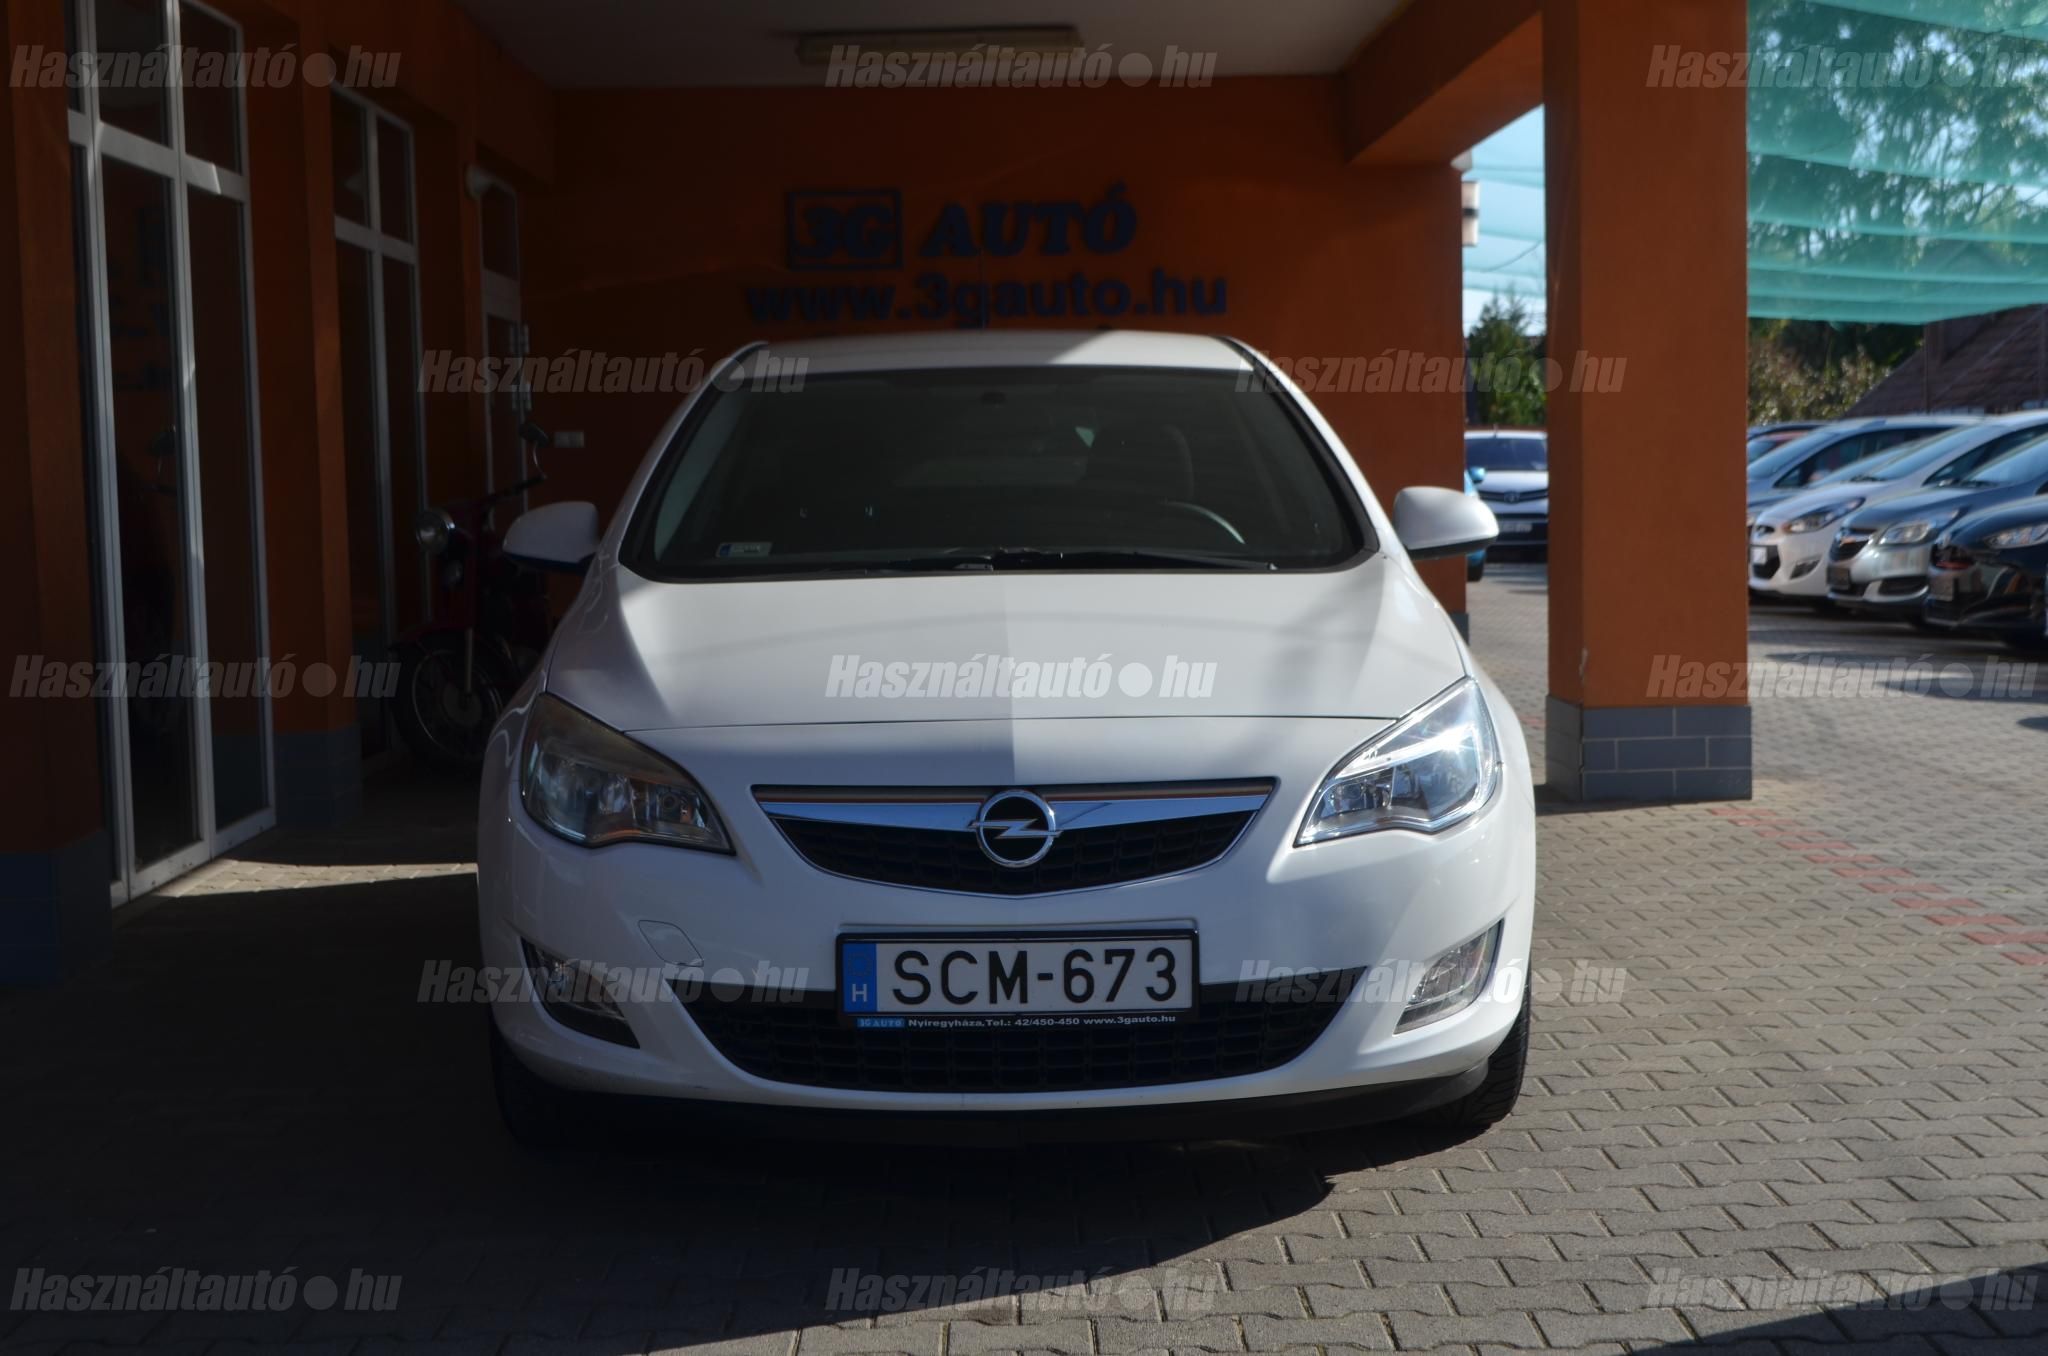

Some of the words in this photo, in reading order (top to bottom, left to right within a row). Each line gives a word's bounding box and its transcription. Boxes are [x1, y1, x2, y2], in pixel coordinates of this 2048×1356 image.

[798, 204, 896, 259] 3G
[921, 180, 1137, 257] AUTÓ
[745, 267, 1228, 327] www.3gauto.hu
[852, 984, 868, 1002] H
[892, 947, 1177, 1005] SCM-673
[1014, 1017, 1080, 1026] 42/450-450
[1083, 1015, 1176, 1025] www.3gauto.hu
